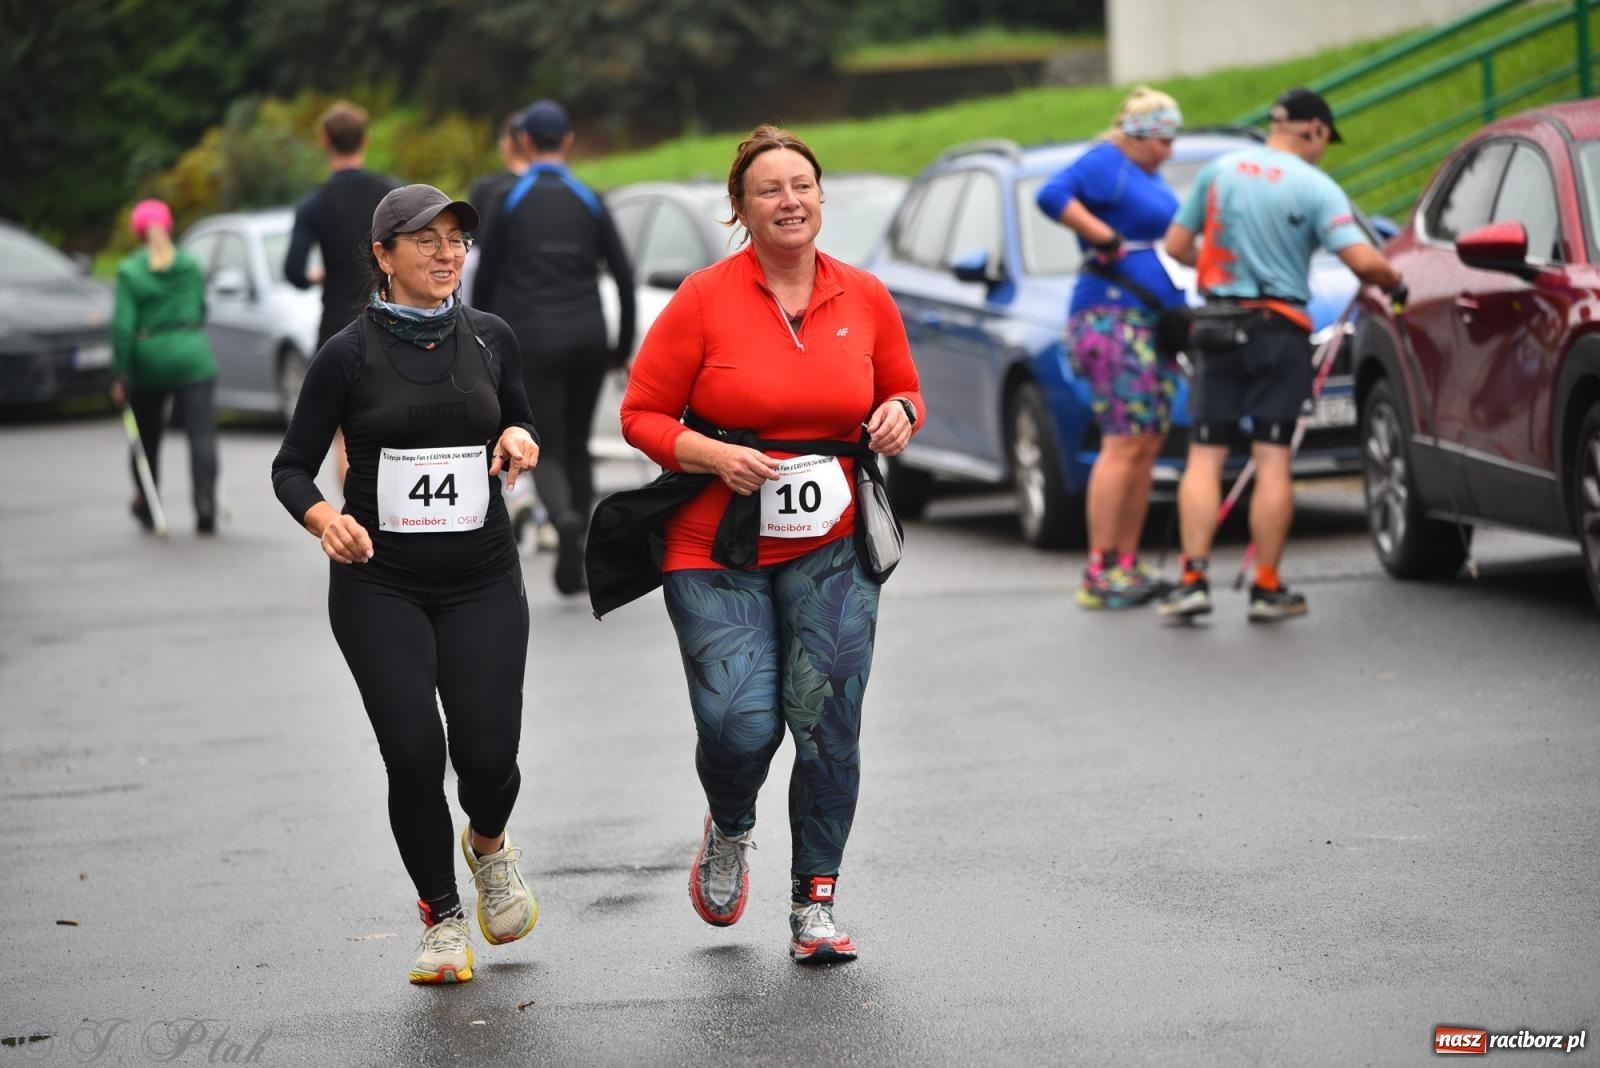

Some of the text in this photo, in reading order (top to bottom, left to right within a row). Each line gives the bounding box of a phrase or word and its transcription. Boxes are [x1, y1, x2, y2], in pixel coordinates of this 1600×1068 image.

[408, 473, 459, 507] 44
[776, 480, 822, 514] 10
[402, 515, 478, 526] Racibórz OSiR
[767, 523, 812, 532] Racibórz
